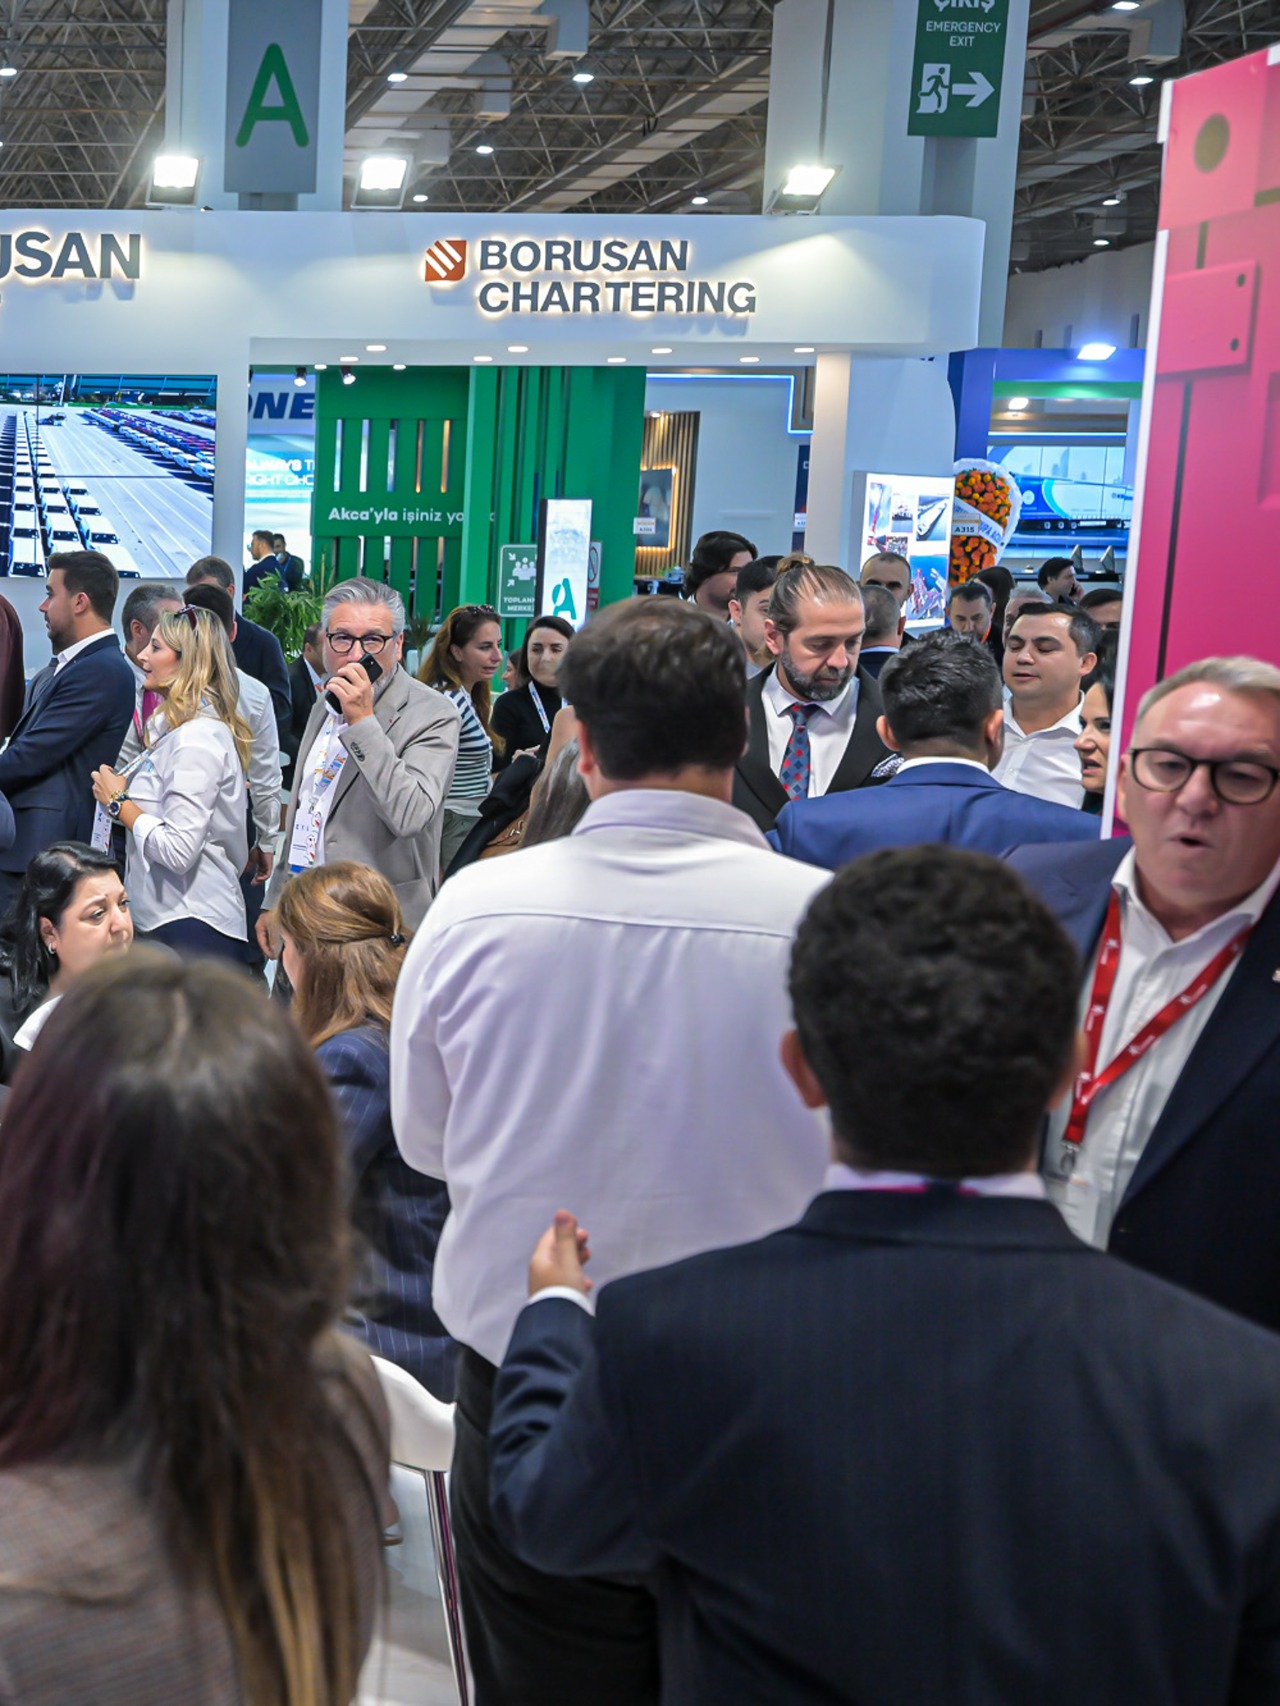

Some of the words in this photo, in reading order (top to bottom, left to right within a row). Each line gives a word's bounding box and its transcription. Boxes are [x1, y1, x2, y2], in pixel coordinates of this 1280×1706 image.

[926, 21, 1001, 33] EMERGENCY
[949, 35, 975, 47] EXIT
[235, 42, 309, 148] A
[479, 240, 688, 272] BORUSAN
[479, 281, 756, 313] CHARTERING
[248, 392, 315, 419] NE
[328, 507, 398, 524] Akca'yla
[403, 508, 442, 524] işiniz
